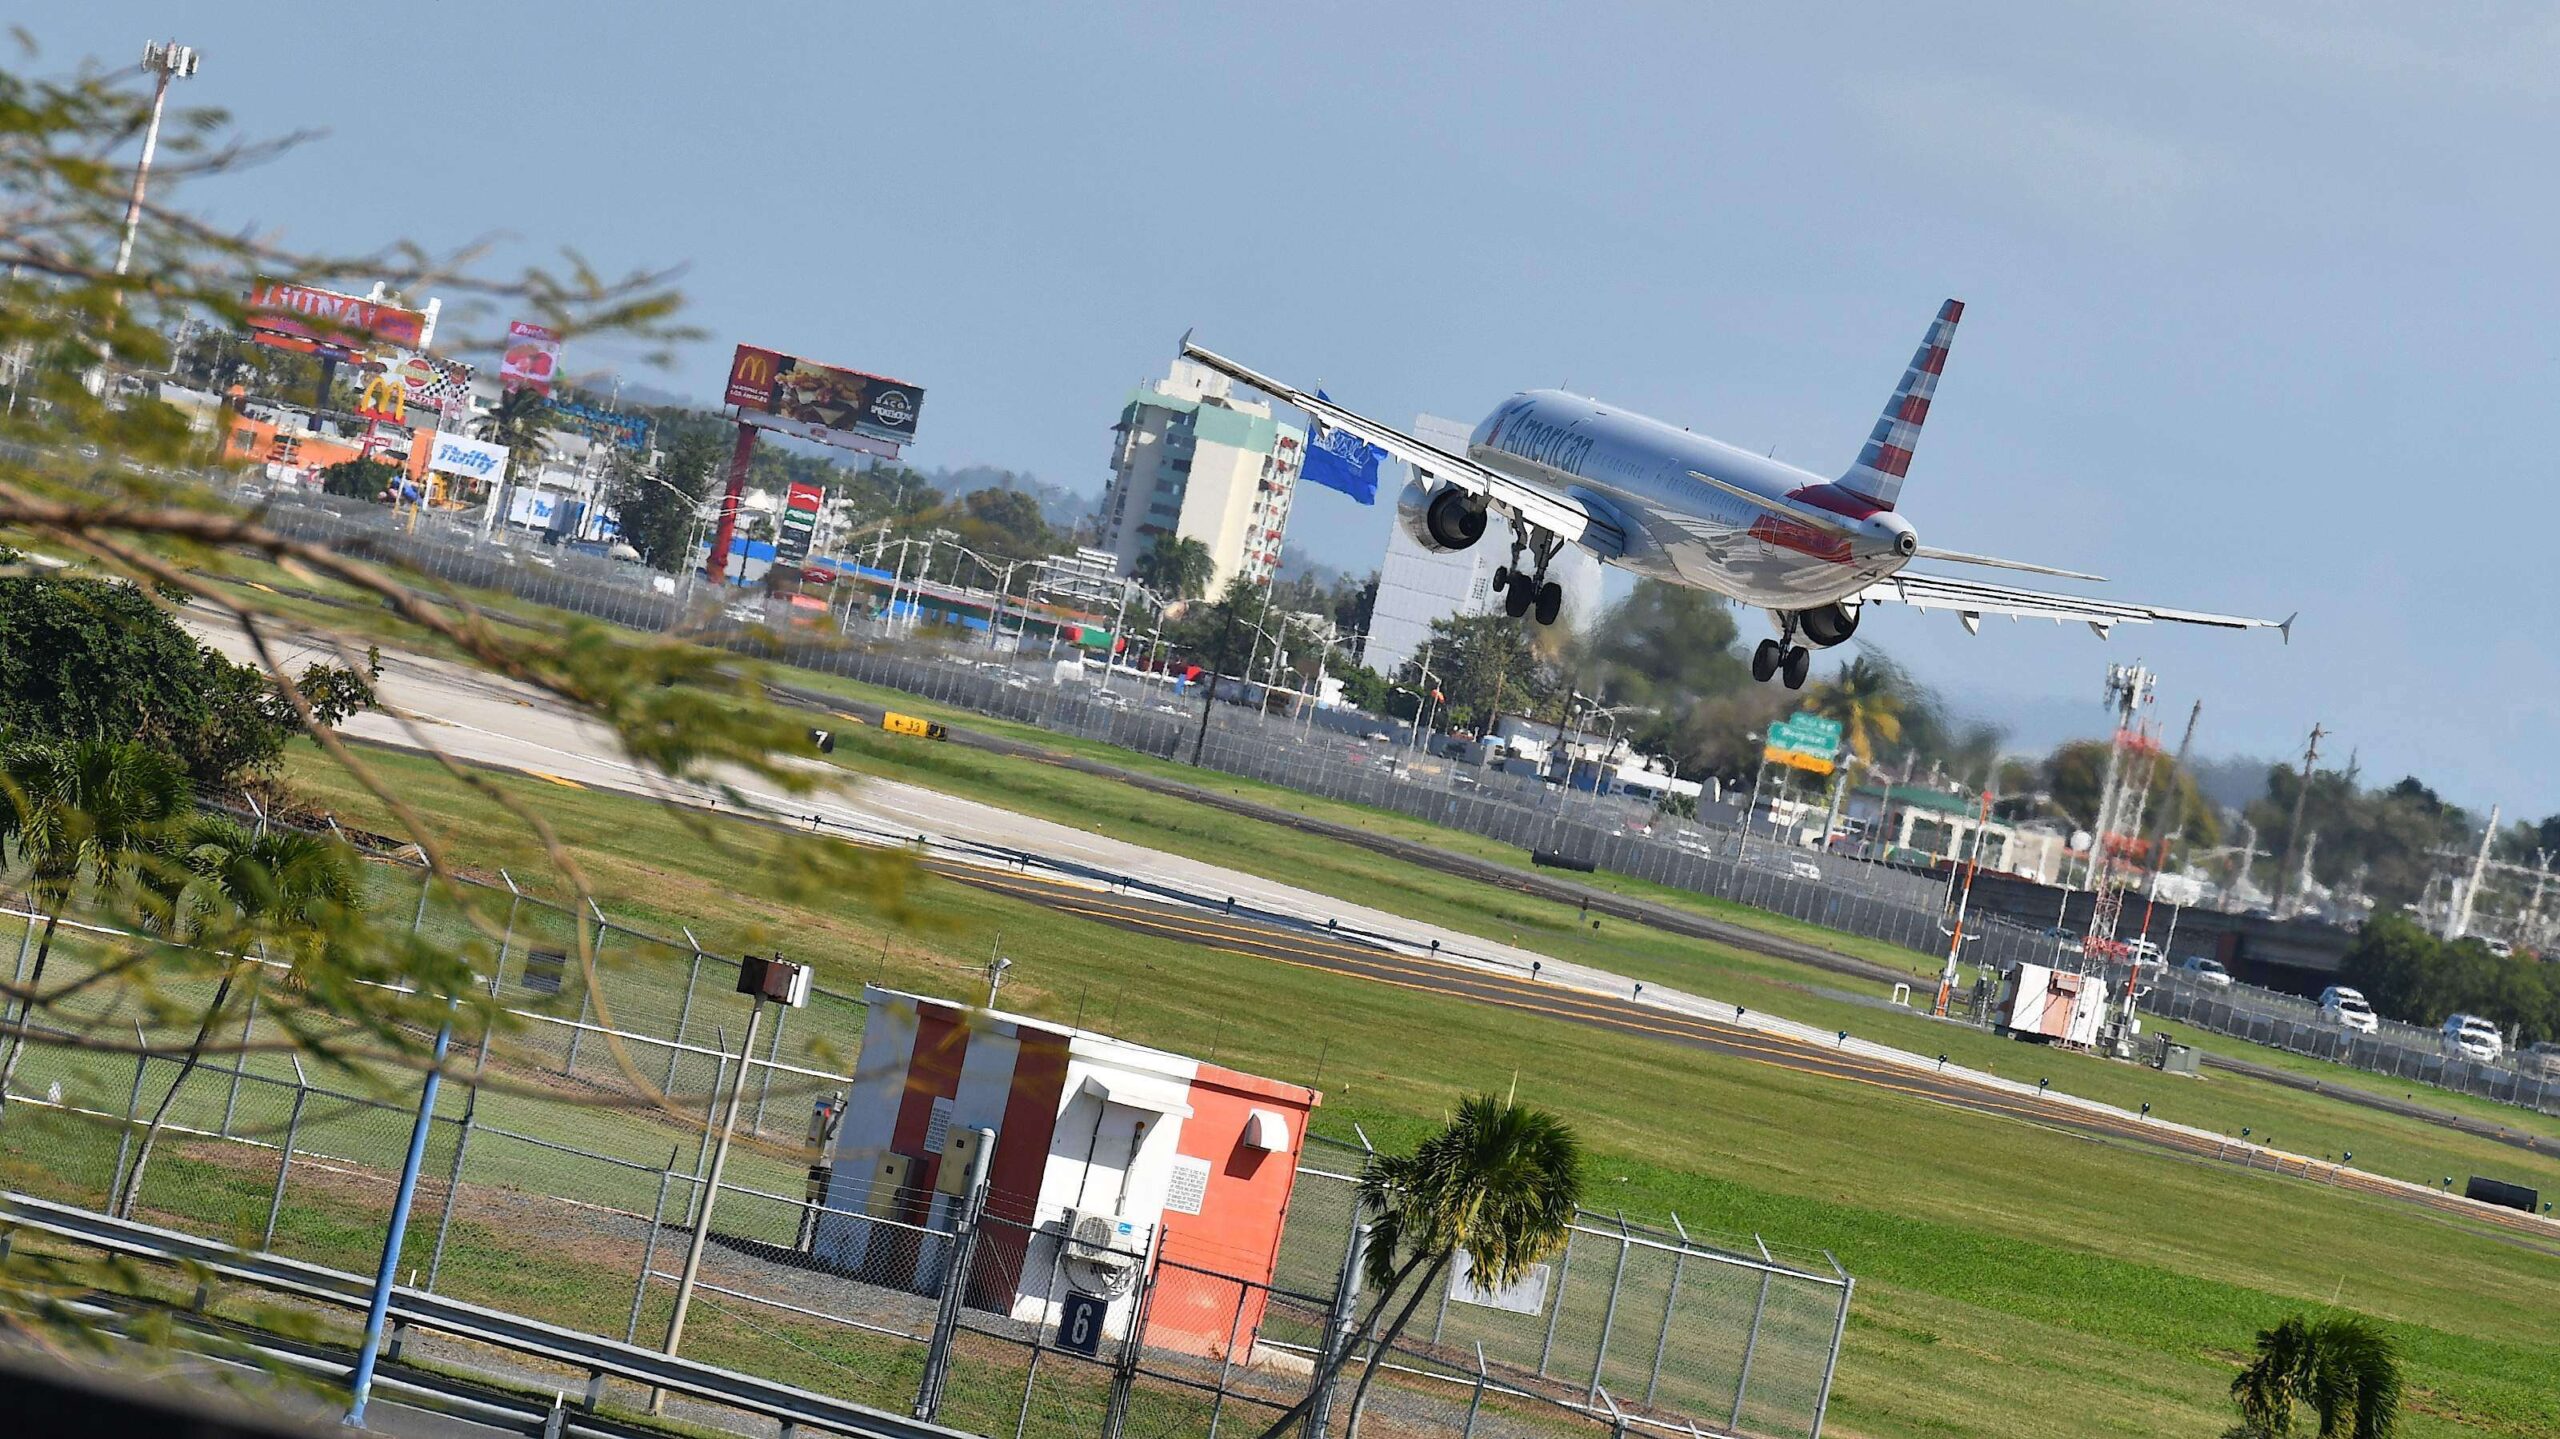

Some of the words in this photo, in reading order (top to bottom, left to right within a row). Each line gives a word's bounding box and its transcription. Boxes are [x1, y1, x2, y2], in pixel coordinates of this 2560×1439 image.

[875, 396, 912, 411] BACON
[1502, 409, 1594, 476] American
[438, 444, 499, 475] Thrifty
[815, 730, 829, 749] 7
[1071, 1303, 1093, 1345] 6
